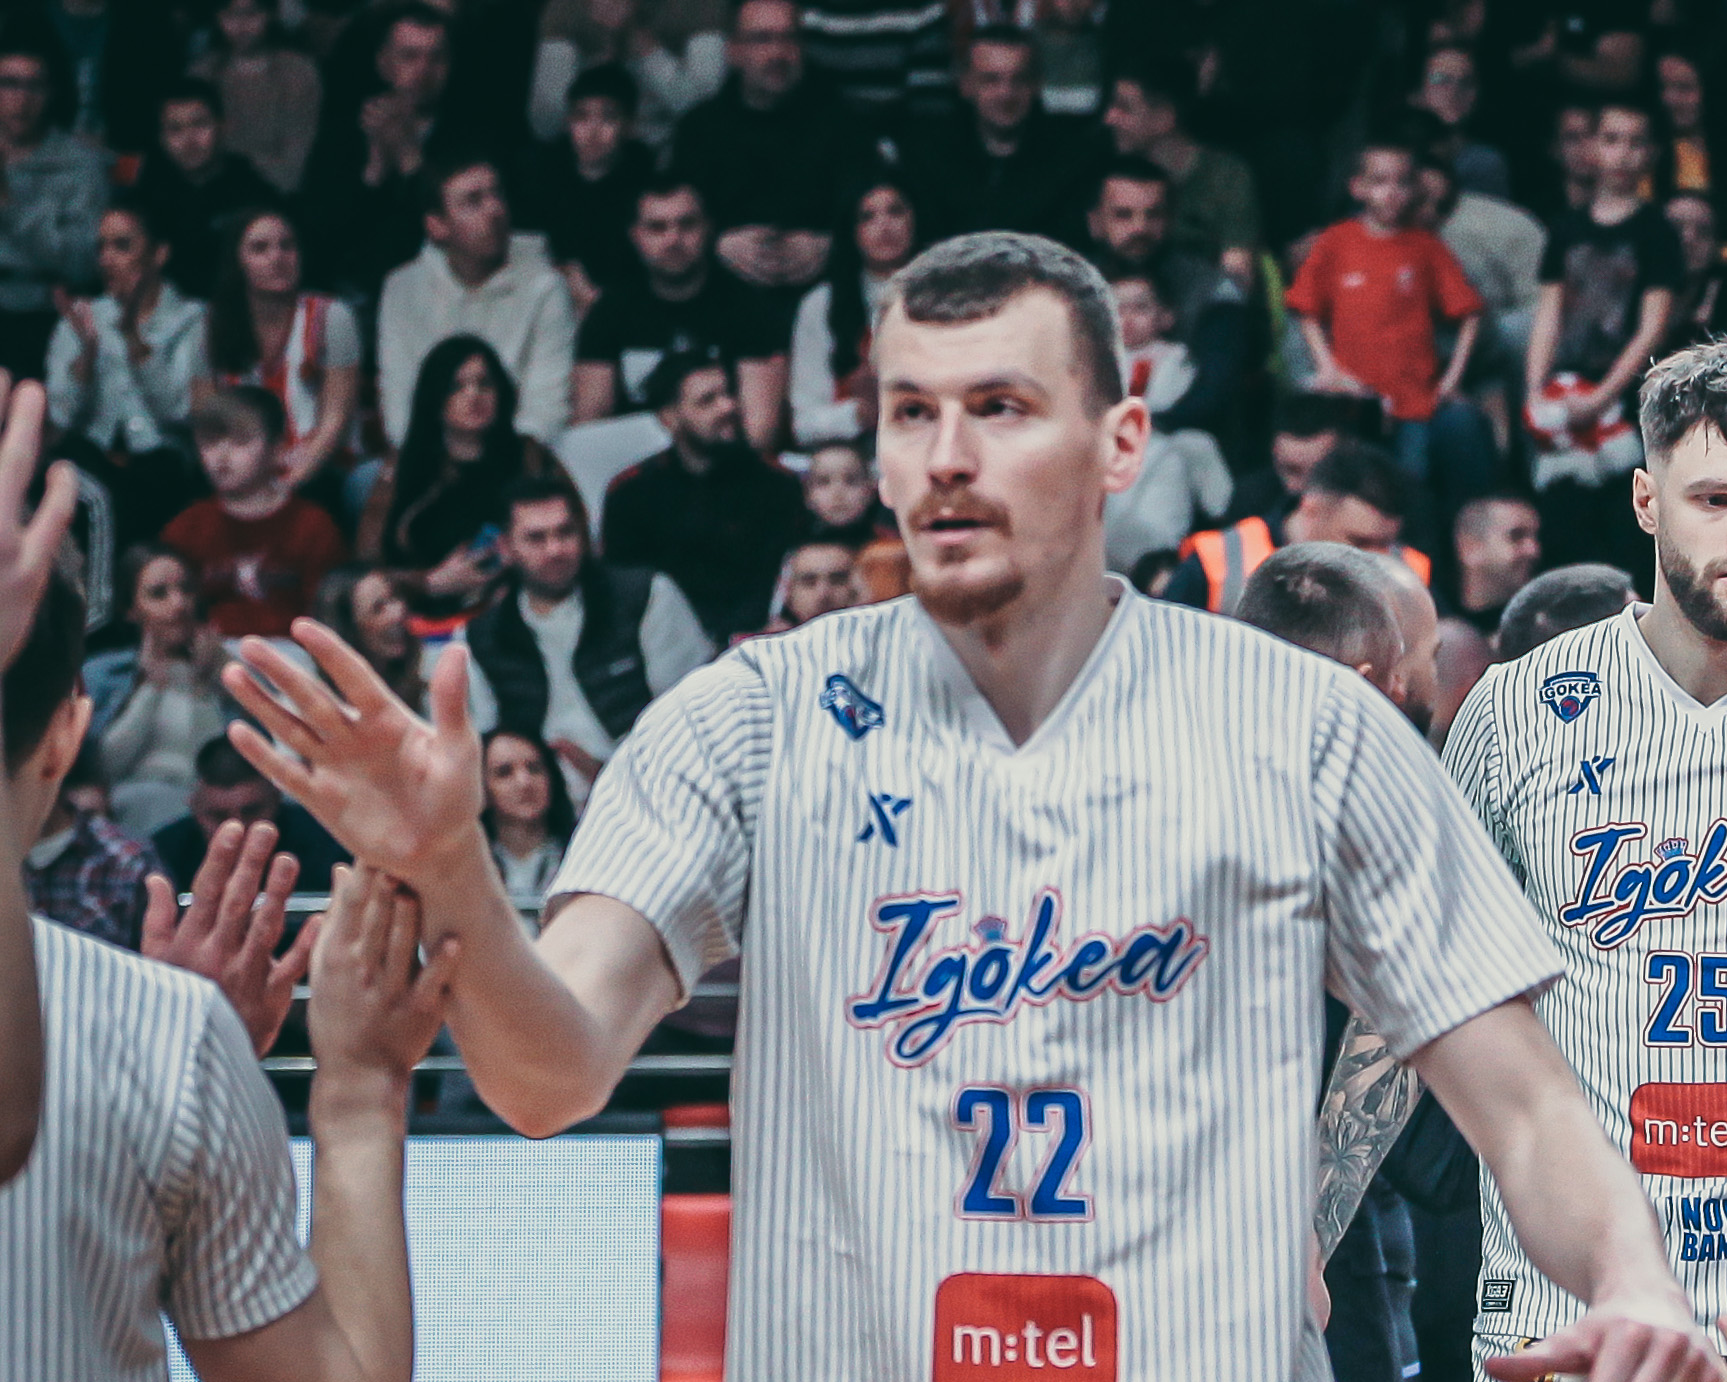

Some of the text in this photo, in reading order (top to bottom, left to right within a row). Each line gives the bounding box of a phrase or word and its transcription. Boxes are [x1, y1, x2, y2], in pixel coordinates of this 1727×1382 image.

[1540, 682, 1602, 702] IGOKEA
[846, 886, 1208, 1069] Igokea
[951, 1082, 1095, 1222] 22
[952, 1314, 1098, 1370] m:tel
